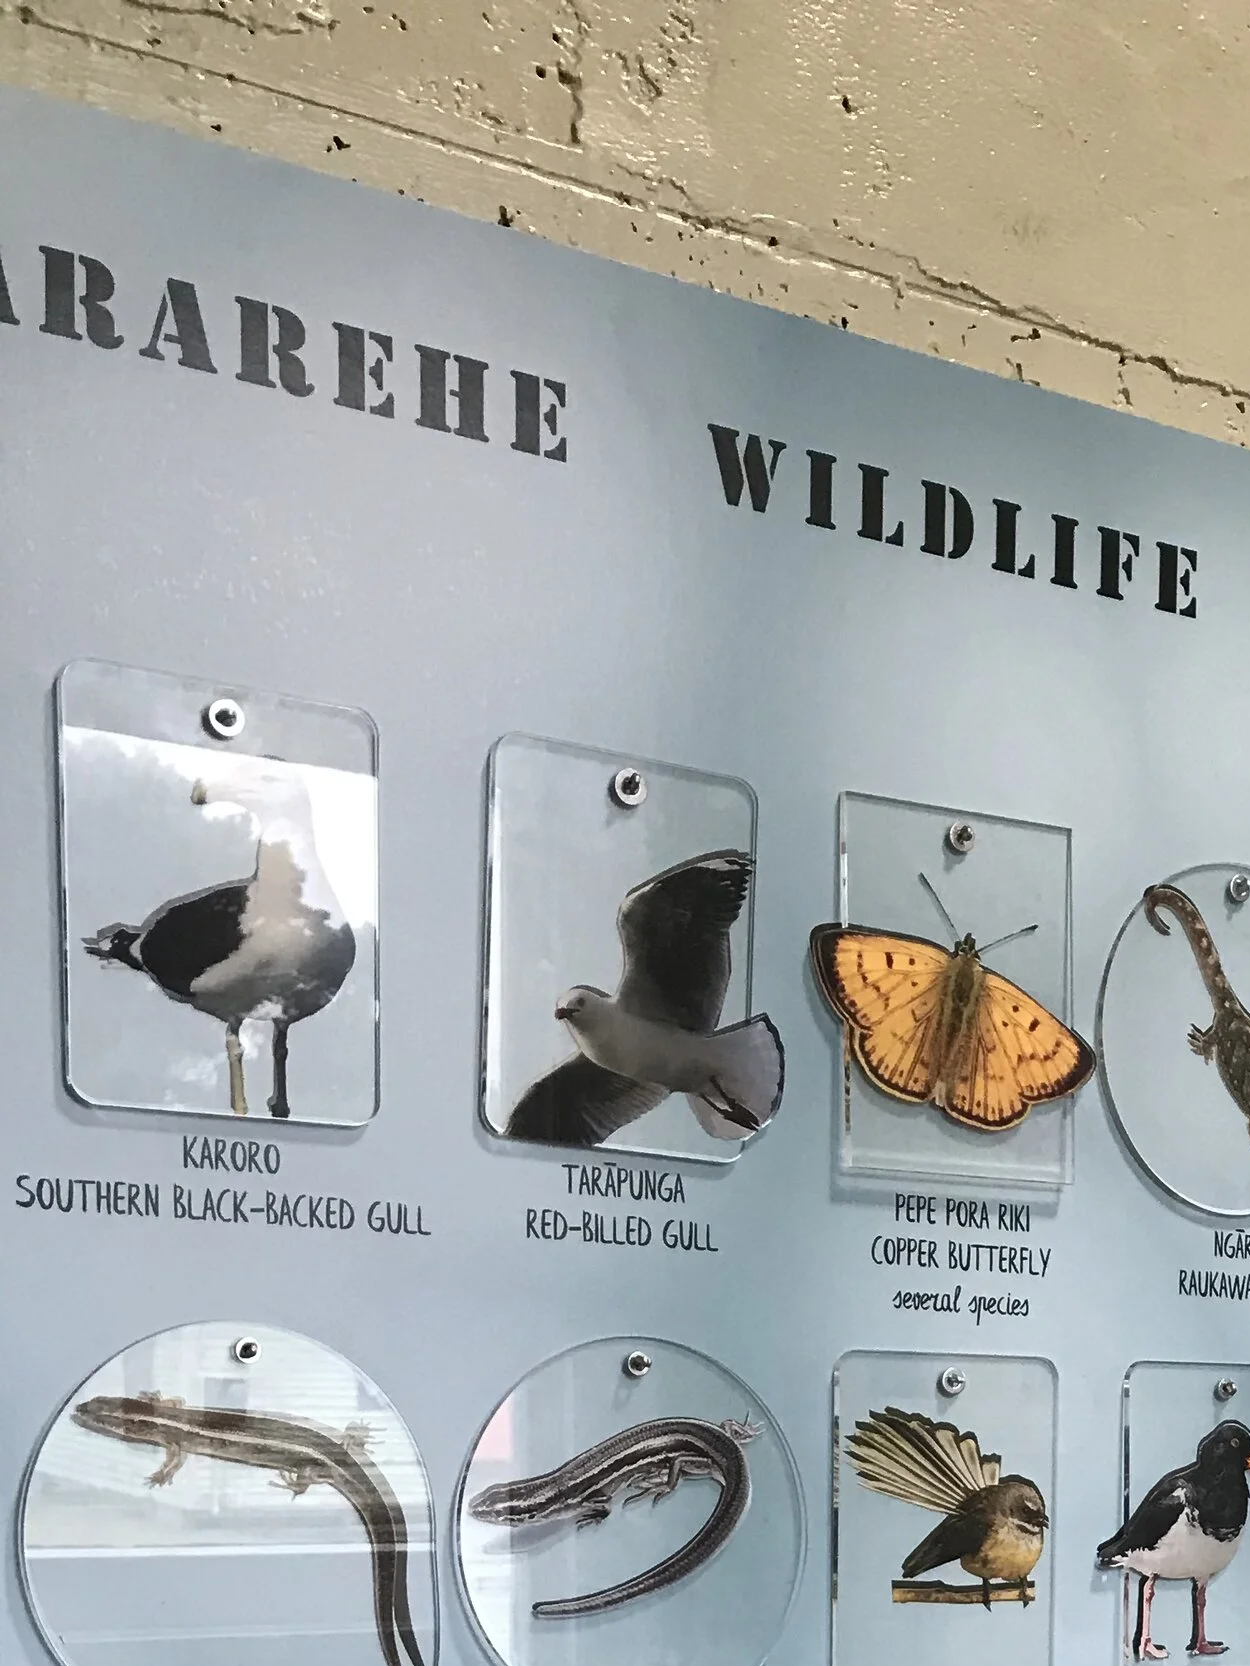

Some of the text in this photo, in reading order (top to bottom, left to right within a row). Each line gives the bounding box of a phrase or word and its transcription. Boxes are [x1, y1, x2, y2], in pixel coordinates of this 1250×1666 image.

[0, 246, 1197, 619] RAREHE WILDLIFE
[183, 1135, 281, 1174] KARORO
[561, 1161, 686, 1204] TARĀPUNGA
[16, 1174, 432, 1236] SOUTHERN BLACK-BACKED GULL
[895, 1192, 1031, 1233] PEPE PORA RIKI
[526, 1208, 719, 1252] RED-BILLED GULL
[871, 1235, 1052, 1278] COPPER BUTTERFLY
[892, 1285, 1030, 1326] several species
